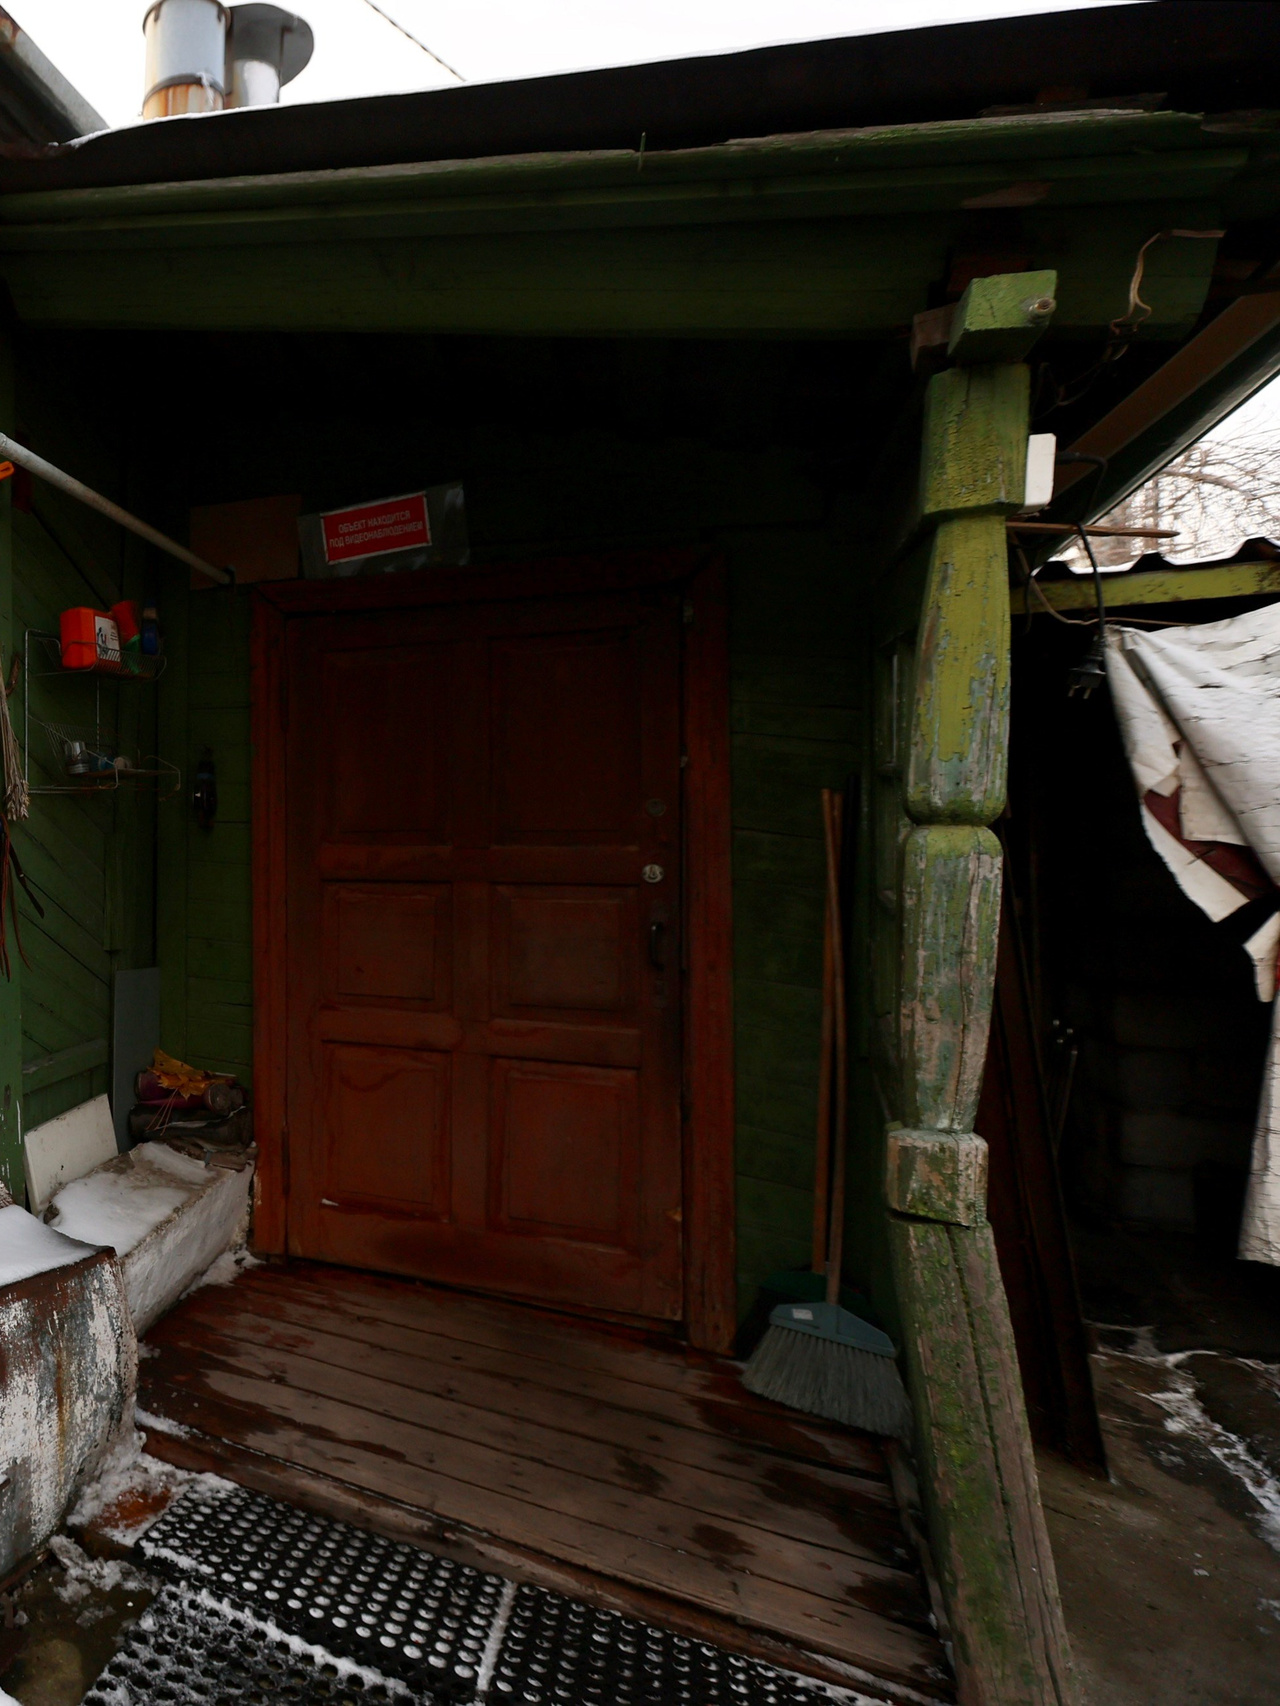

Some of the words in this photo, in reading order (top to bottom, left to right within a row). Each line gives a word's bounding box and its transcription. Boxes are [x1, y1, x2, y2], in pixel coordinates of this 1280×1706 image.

[329, 537, 345, 549] ПОД
[345, 521, 424, 545] ВИДЕОНАБЛЮДЕНИЕМ
[338, 520, 366, 534] ОБЪЕКТ
[367, 510, 411, 528] НАХОДИТСЯ
